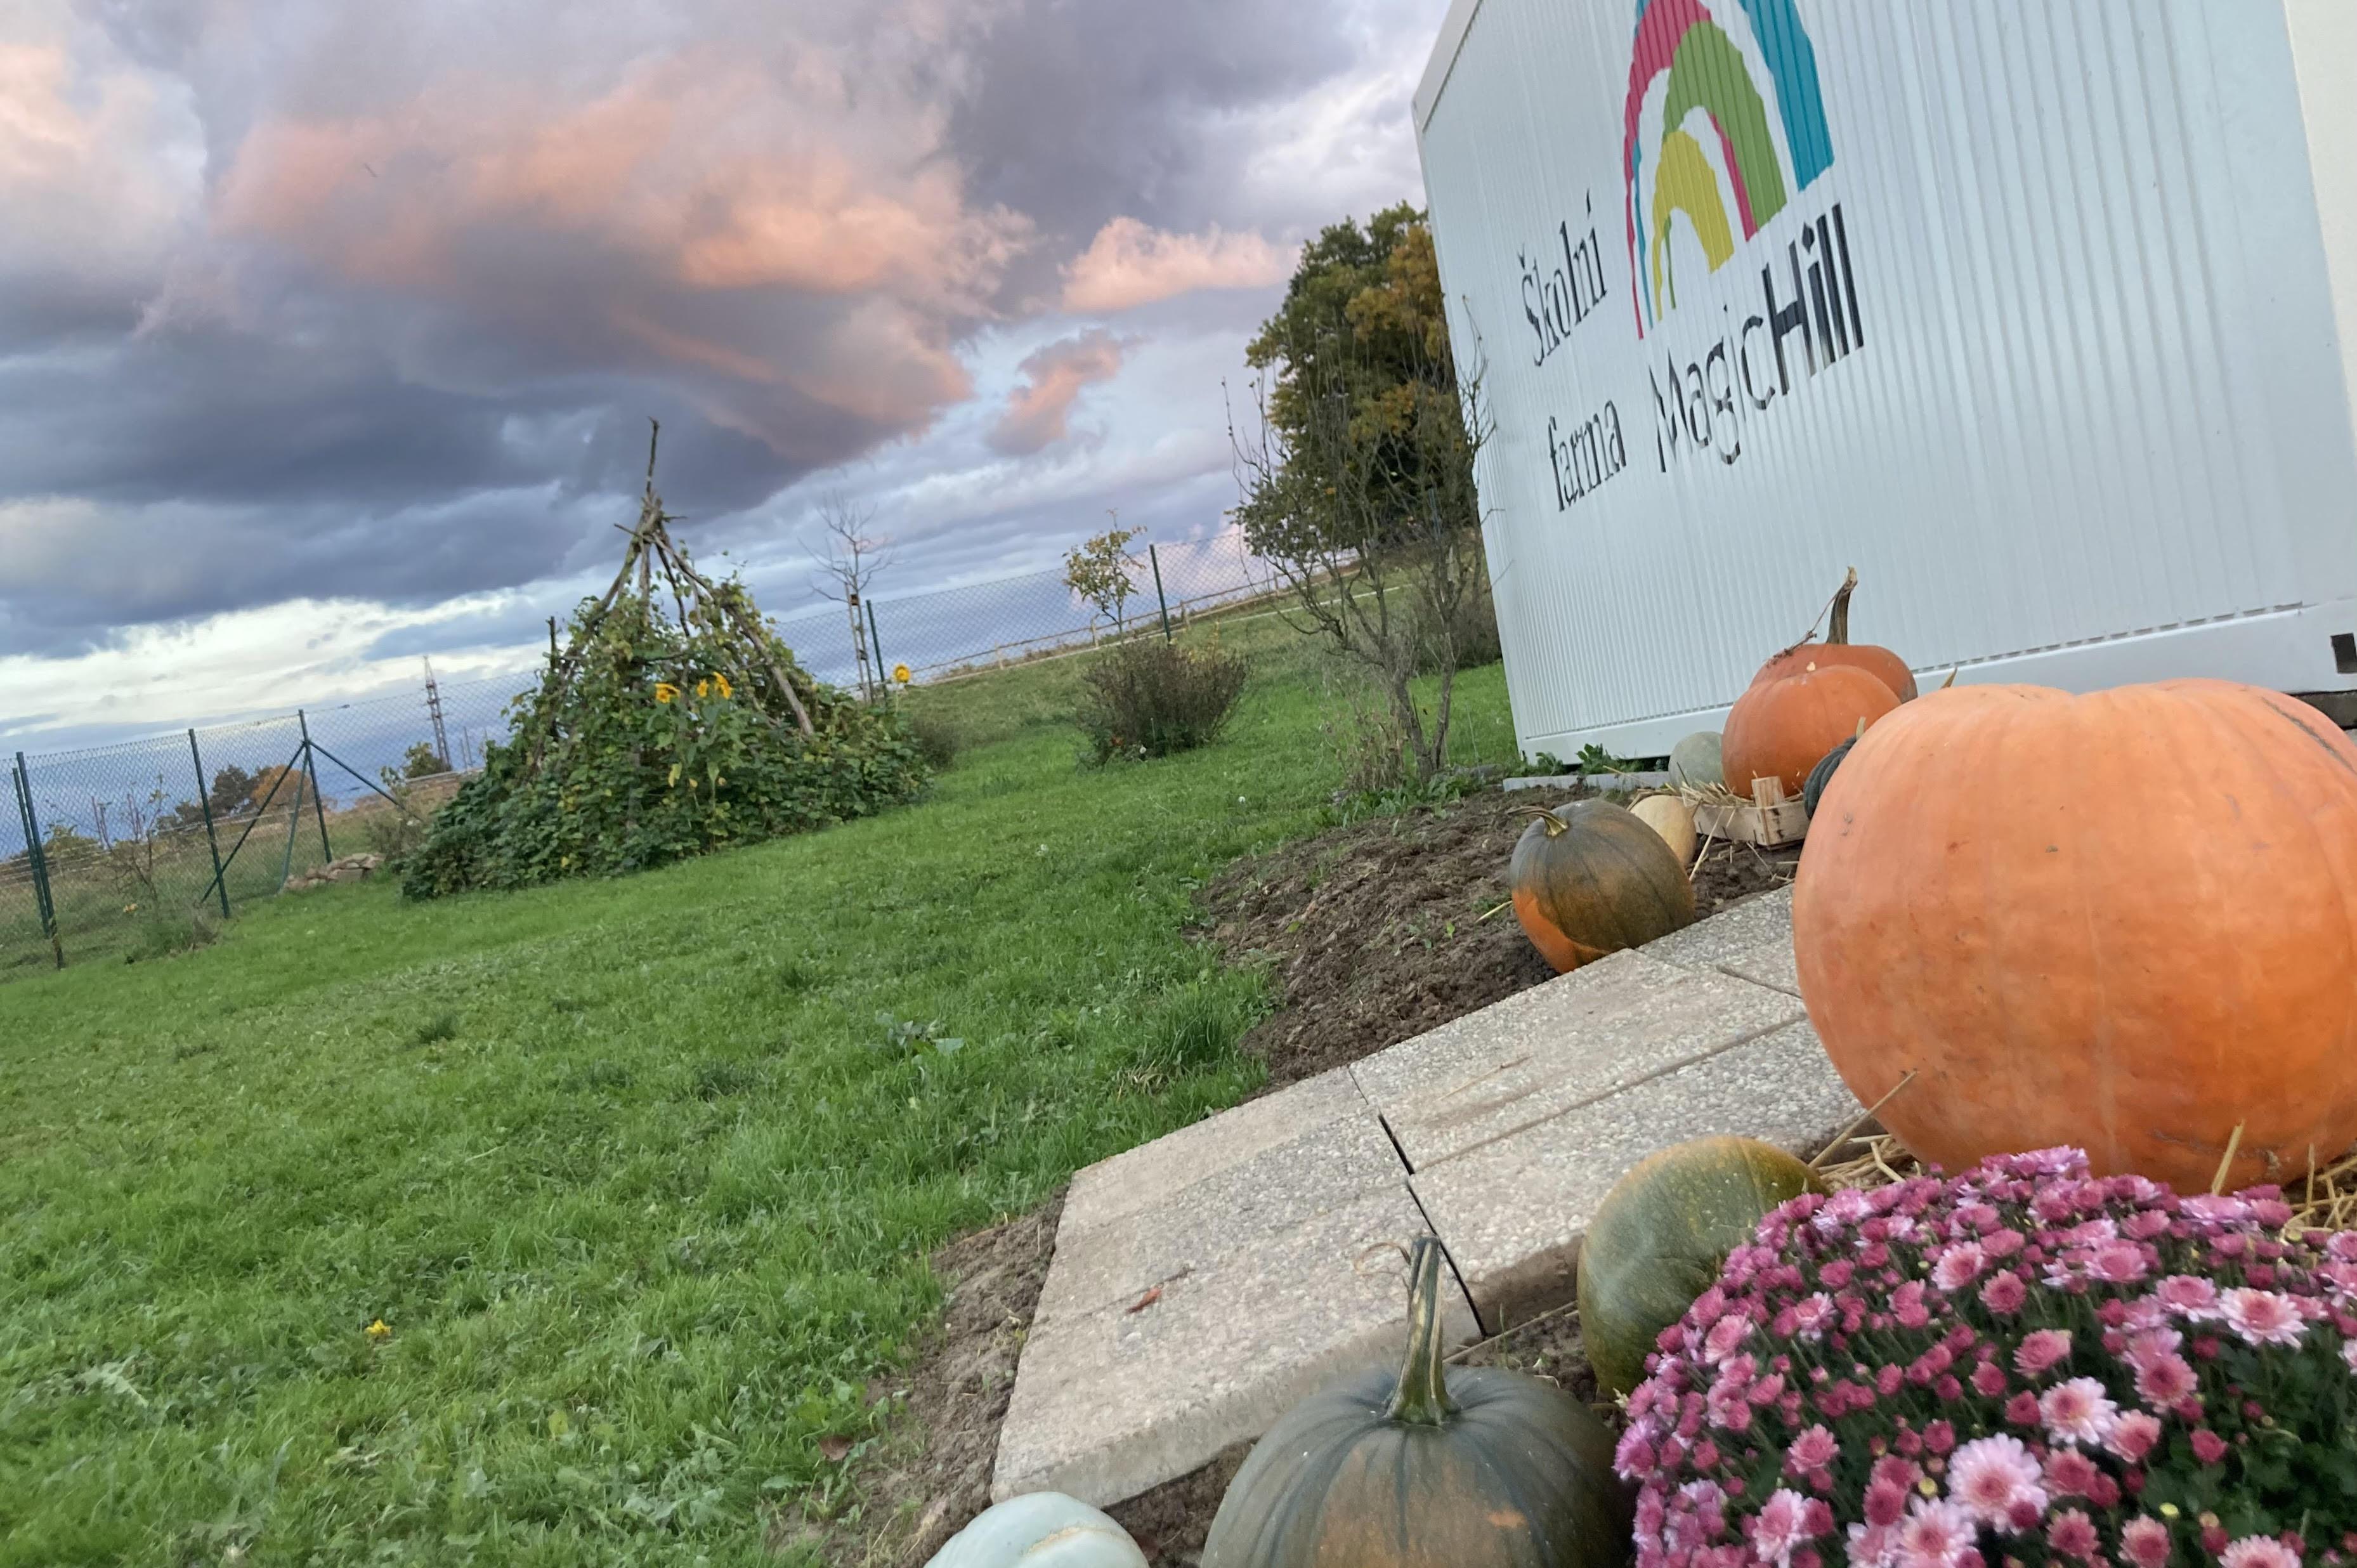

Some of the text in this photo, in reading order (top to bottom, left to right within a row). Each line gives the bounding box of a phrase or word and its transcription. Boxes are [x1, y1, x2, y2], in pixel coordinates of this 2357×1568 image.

[1518, 188, 1607, 366] Školní
[1649, 203, 1863, 473] MagicHill
[1548, 400, 1626, 511] farma
